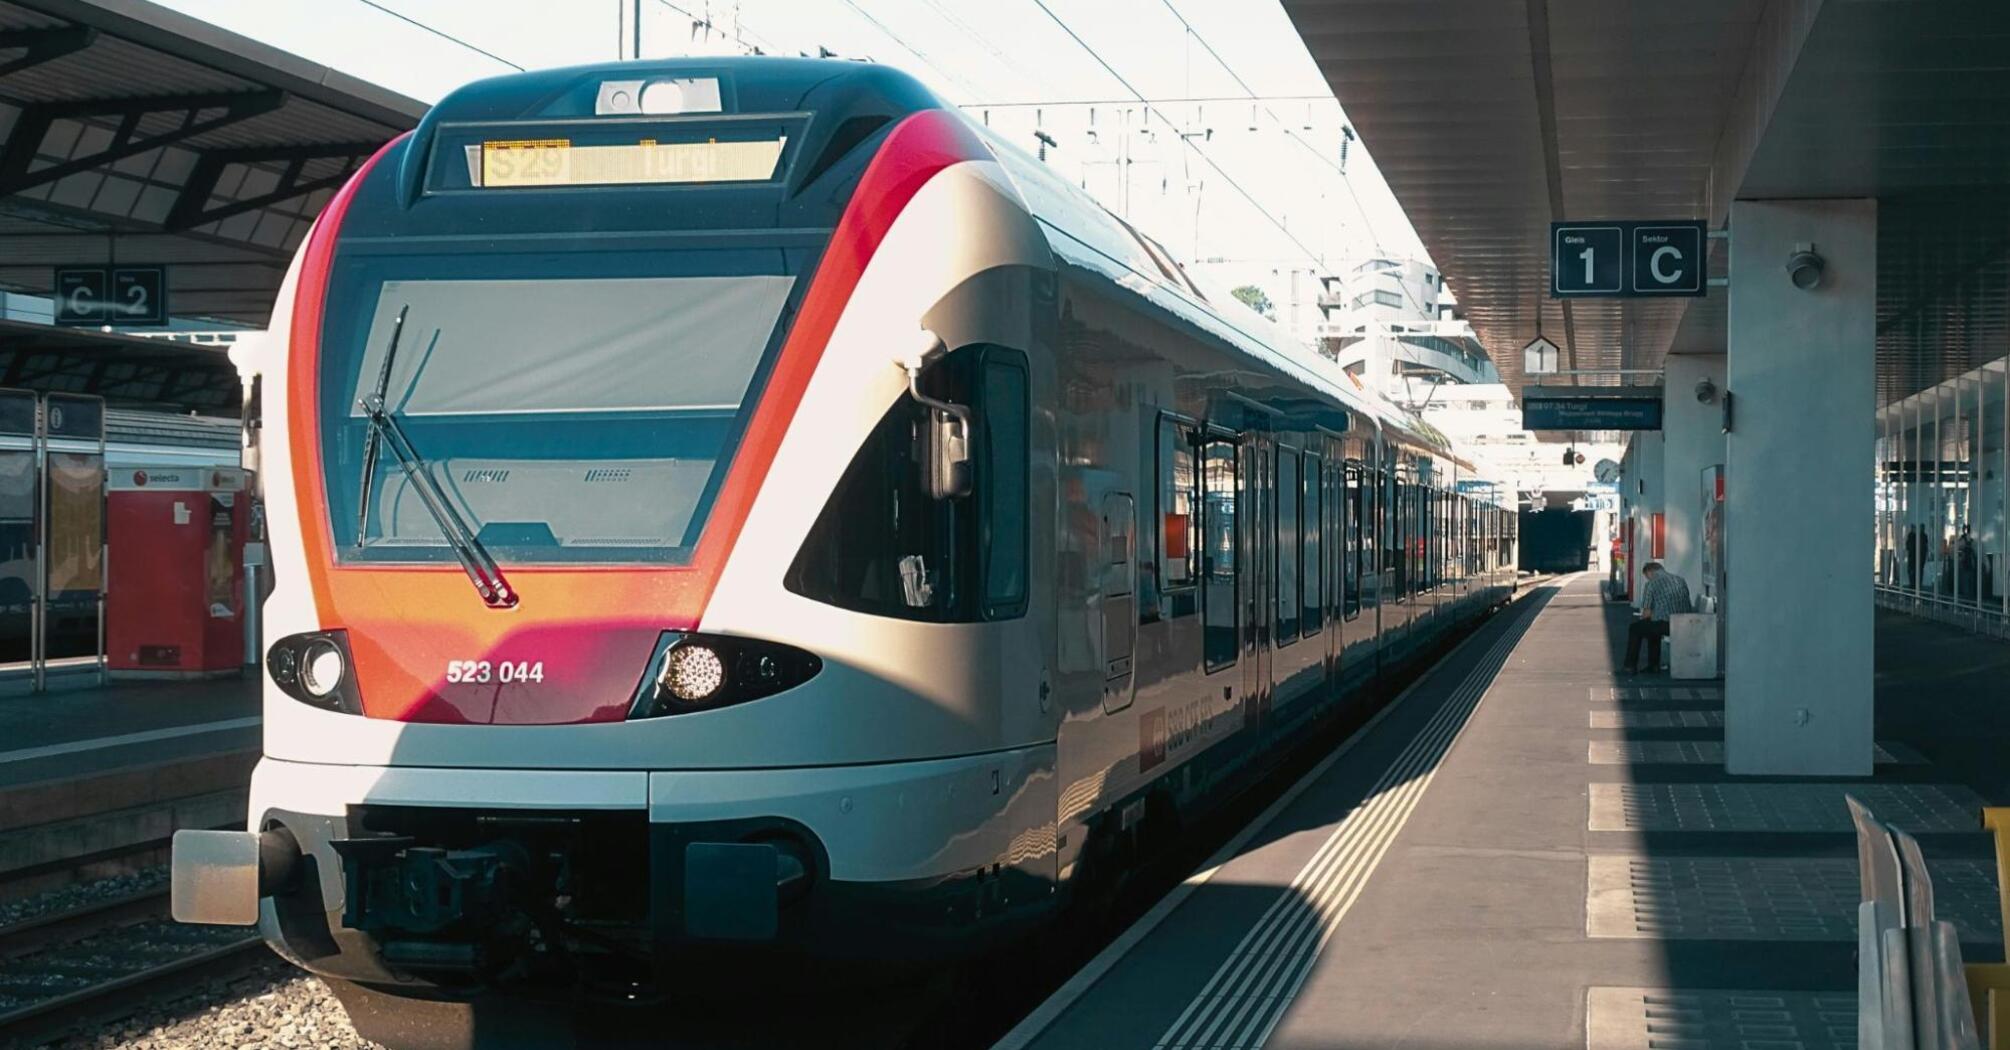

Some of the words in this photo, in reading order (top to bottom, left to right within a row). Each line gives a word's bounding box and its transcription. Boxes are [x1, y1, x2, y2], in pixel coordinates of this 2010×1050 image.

[1642, 235, 1669, 243] Sektor
[1579, 247, 1594, 284] 1
[1650, 246, 1683, 284] C
[71, 286, 93, 315] C
[127, 286, 147, 315] 2
[1536, 345, 1545, 372] 1
[149, 474, 180, 483] selecta
[446, 660, 491, 683] 523
[499, 661, 544, 683] 044
